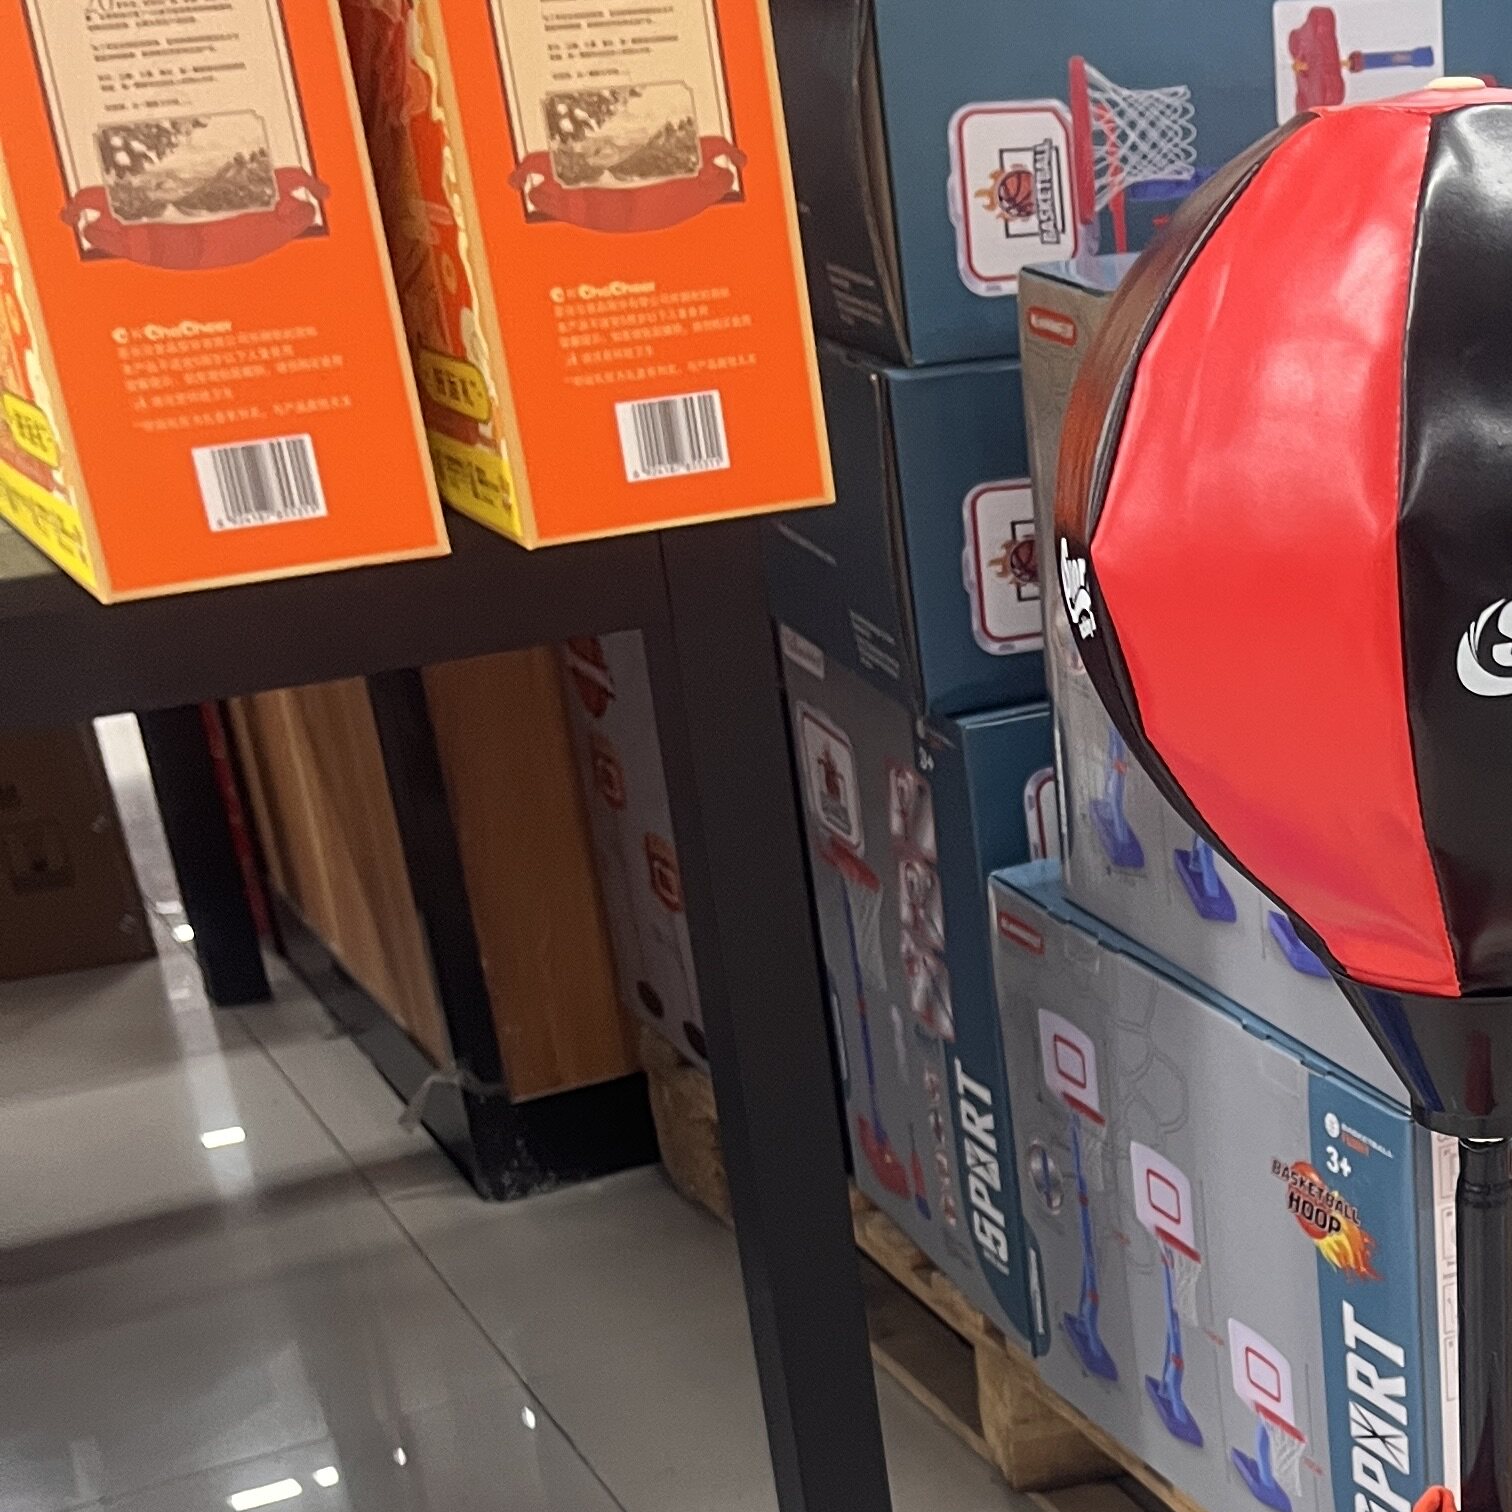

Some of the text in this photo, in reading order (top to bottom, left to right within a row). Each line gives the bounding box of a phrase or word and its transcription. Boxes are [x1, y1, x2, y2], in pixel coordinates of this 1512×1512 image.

[1326, 1145, 1352, 1177] 3+
[1271, 1158, 1361, 1227] BASKETBALL
[1288, 1190, 1342, 1234] HOOP
